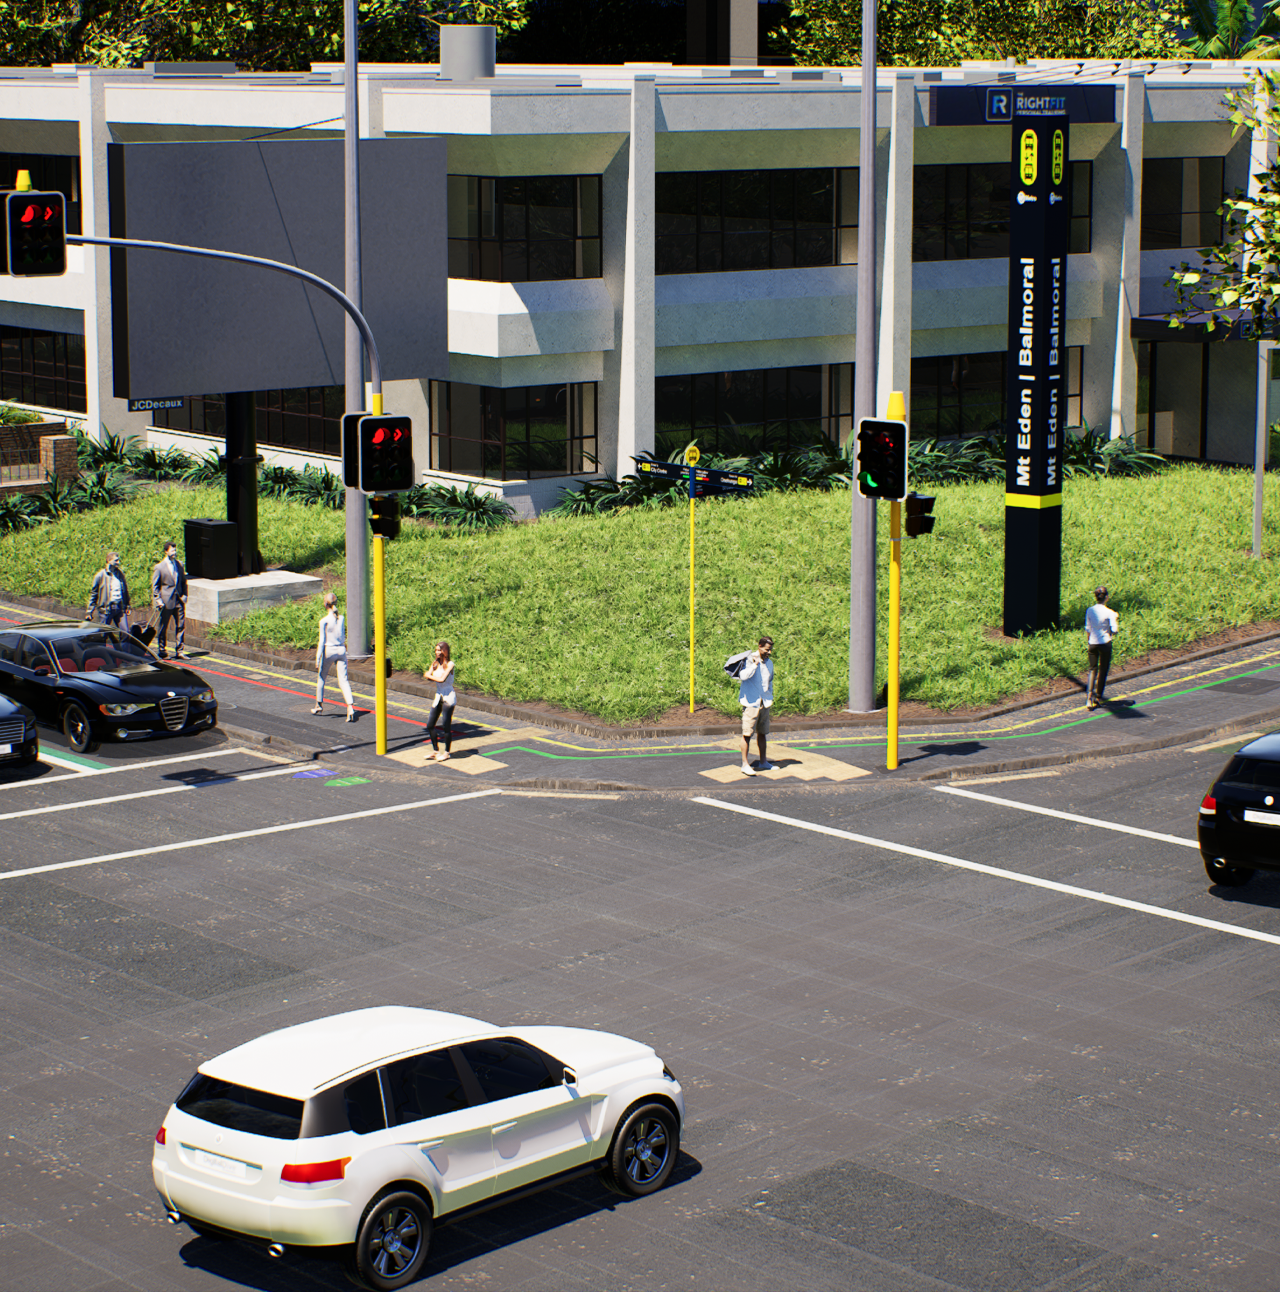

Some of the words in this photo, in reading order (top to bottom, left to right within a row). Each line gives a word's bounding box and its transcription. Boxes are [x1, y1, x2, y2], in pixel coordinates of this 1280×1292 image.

[991, 94, 1008, 115] R
[1016, 96, 1066, 110] RIGHTFIT
[1018, 257, 1035, 367] Balmoral
[1049, 257, 1061, 366] Balmoral
[131, 399, 183, 411] JCDecaux
[1017, 388, 1032, 450] Eden
[1047, 388, 1058, 449] Eden
[1016, 456, 1031, 487] Mt
[1047, 455, 1057, 486] Mt
